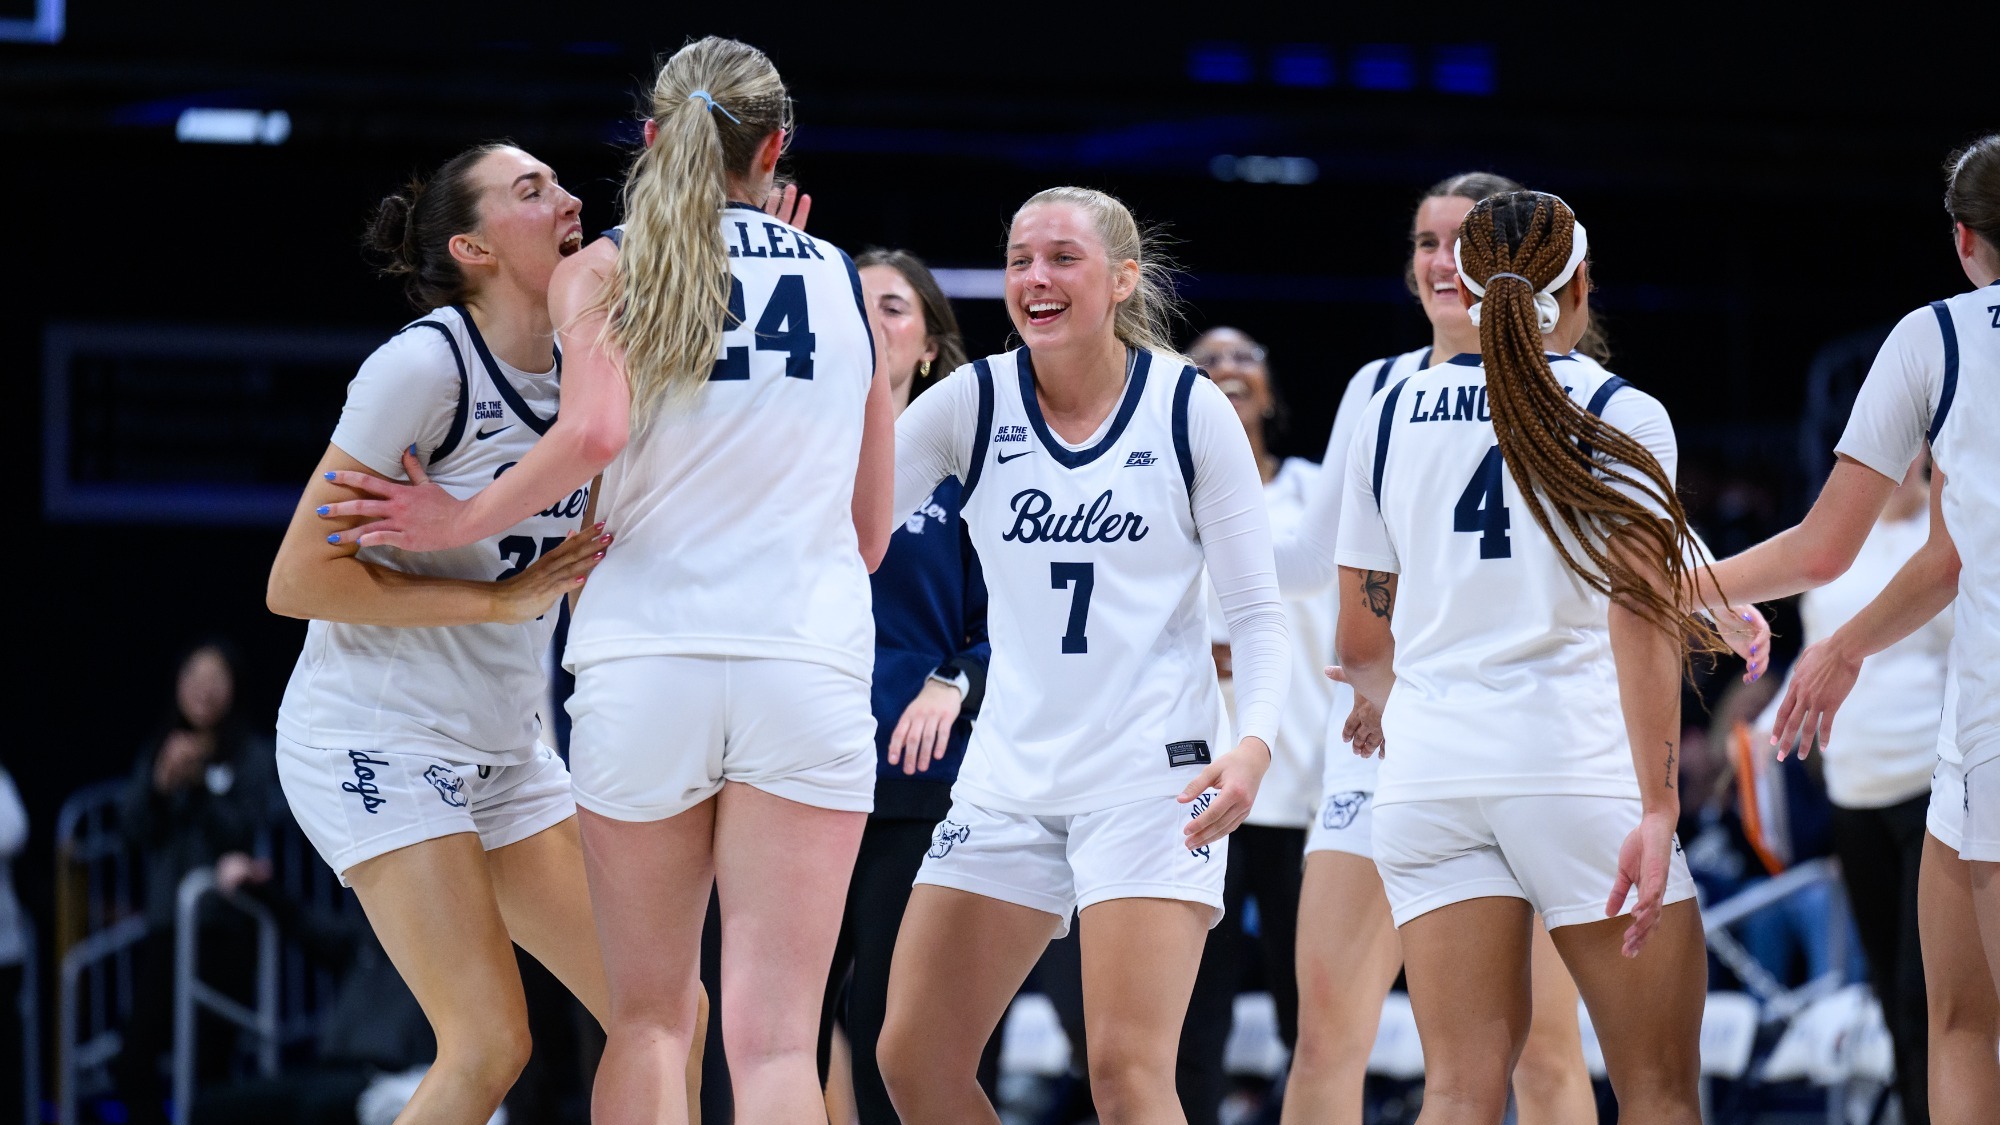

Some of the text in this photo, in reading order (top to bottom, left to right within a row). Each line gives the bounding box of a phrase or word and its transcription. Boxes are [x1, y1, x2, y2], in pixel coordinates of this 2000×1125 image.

[707, 272, 816, 381] 24
[475, 410, 503, 420] CHANGE
[476, 401, 502, 410] BE THE
[998, 426, 1028, 434] BE THE
[994, 434, 1029, 443] CHANGE
[1002, 488, 1149, 543] Butler
[1453, 444, 1511, 560] 4
[1050, 561, 1094, 654] 7
[342, 749, 390, 814] dogs
